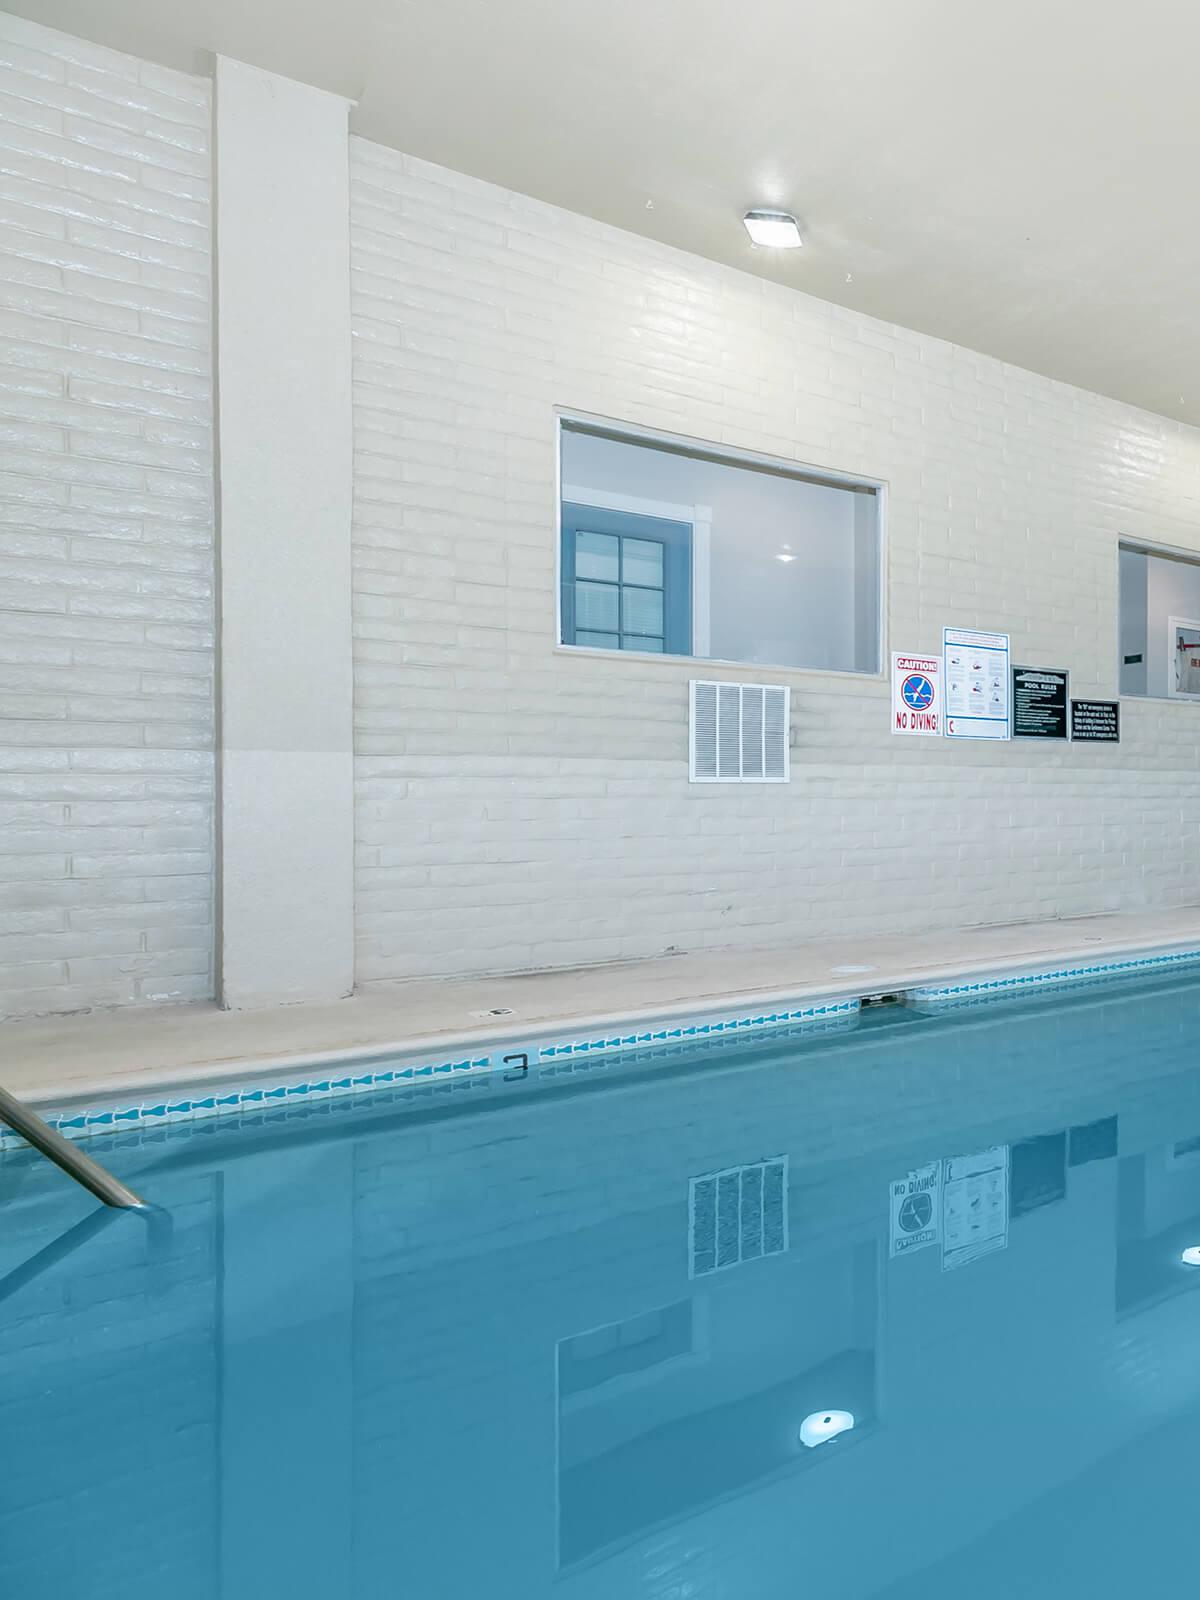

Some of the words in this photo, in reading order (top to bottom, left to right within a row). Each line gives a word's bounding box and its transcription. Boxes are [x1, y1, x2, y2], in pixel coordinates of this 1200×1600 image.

[898, 659, 937, 671] CAUTION!
[896, 712, 907, 729] NO
[911, 713, 939, 730] DIVING!
